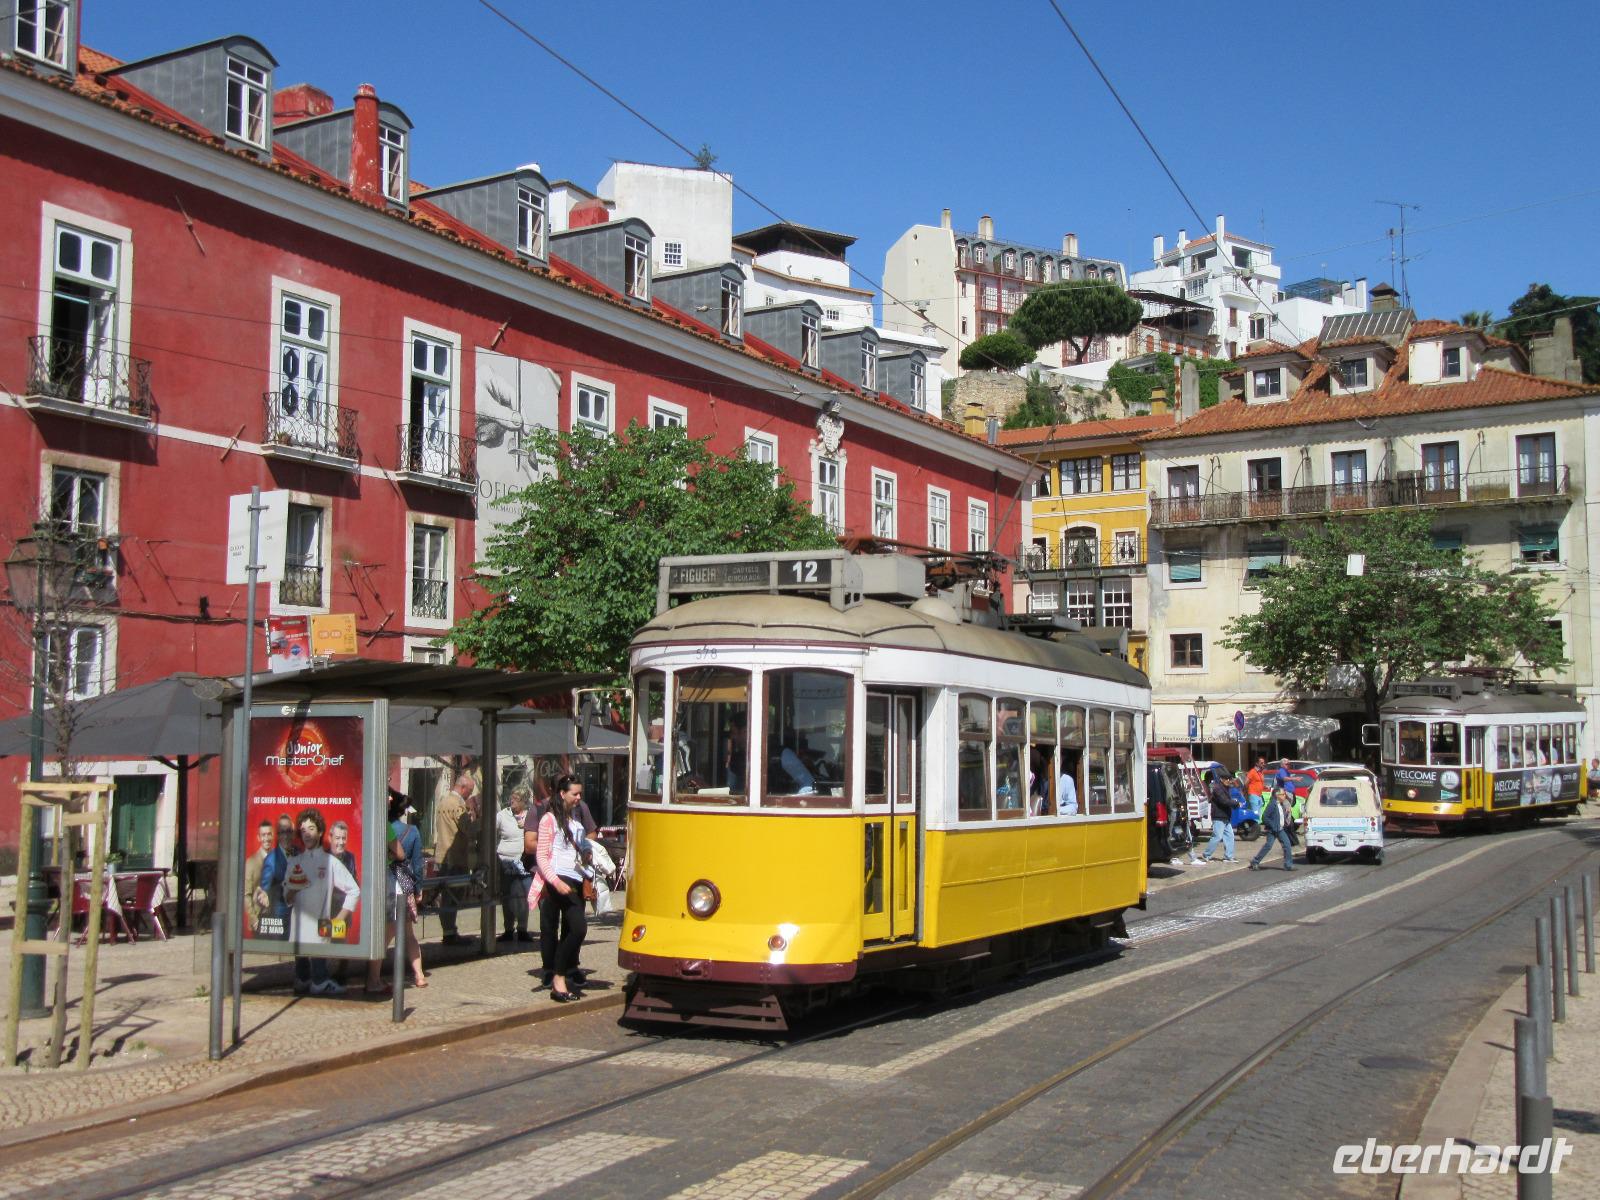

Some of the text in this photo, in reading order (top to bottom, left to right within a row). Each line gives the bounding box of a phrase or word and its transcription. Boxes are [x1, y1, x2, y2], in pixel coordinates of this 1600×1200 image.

[792, 560, 818, 583] 12
[696, 647, 718, 660] 578
[1190, 719, 1196, 734] P
[1393, 769, 1437, 780] WELCOME
[1494, 779, 1521, 792] WELCOME
[253, 796, 260, 804] OS
[277, 795, 289, 804] NÃO
[296, 797, 317, 805] MEDEM
[329, 797, 352, 805] PALMOS
[261, 918, 283, 926] ESTREIA
[269, 926, 284, 935] MAIO
[334, 925, 344, 934] tvi
